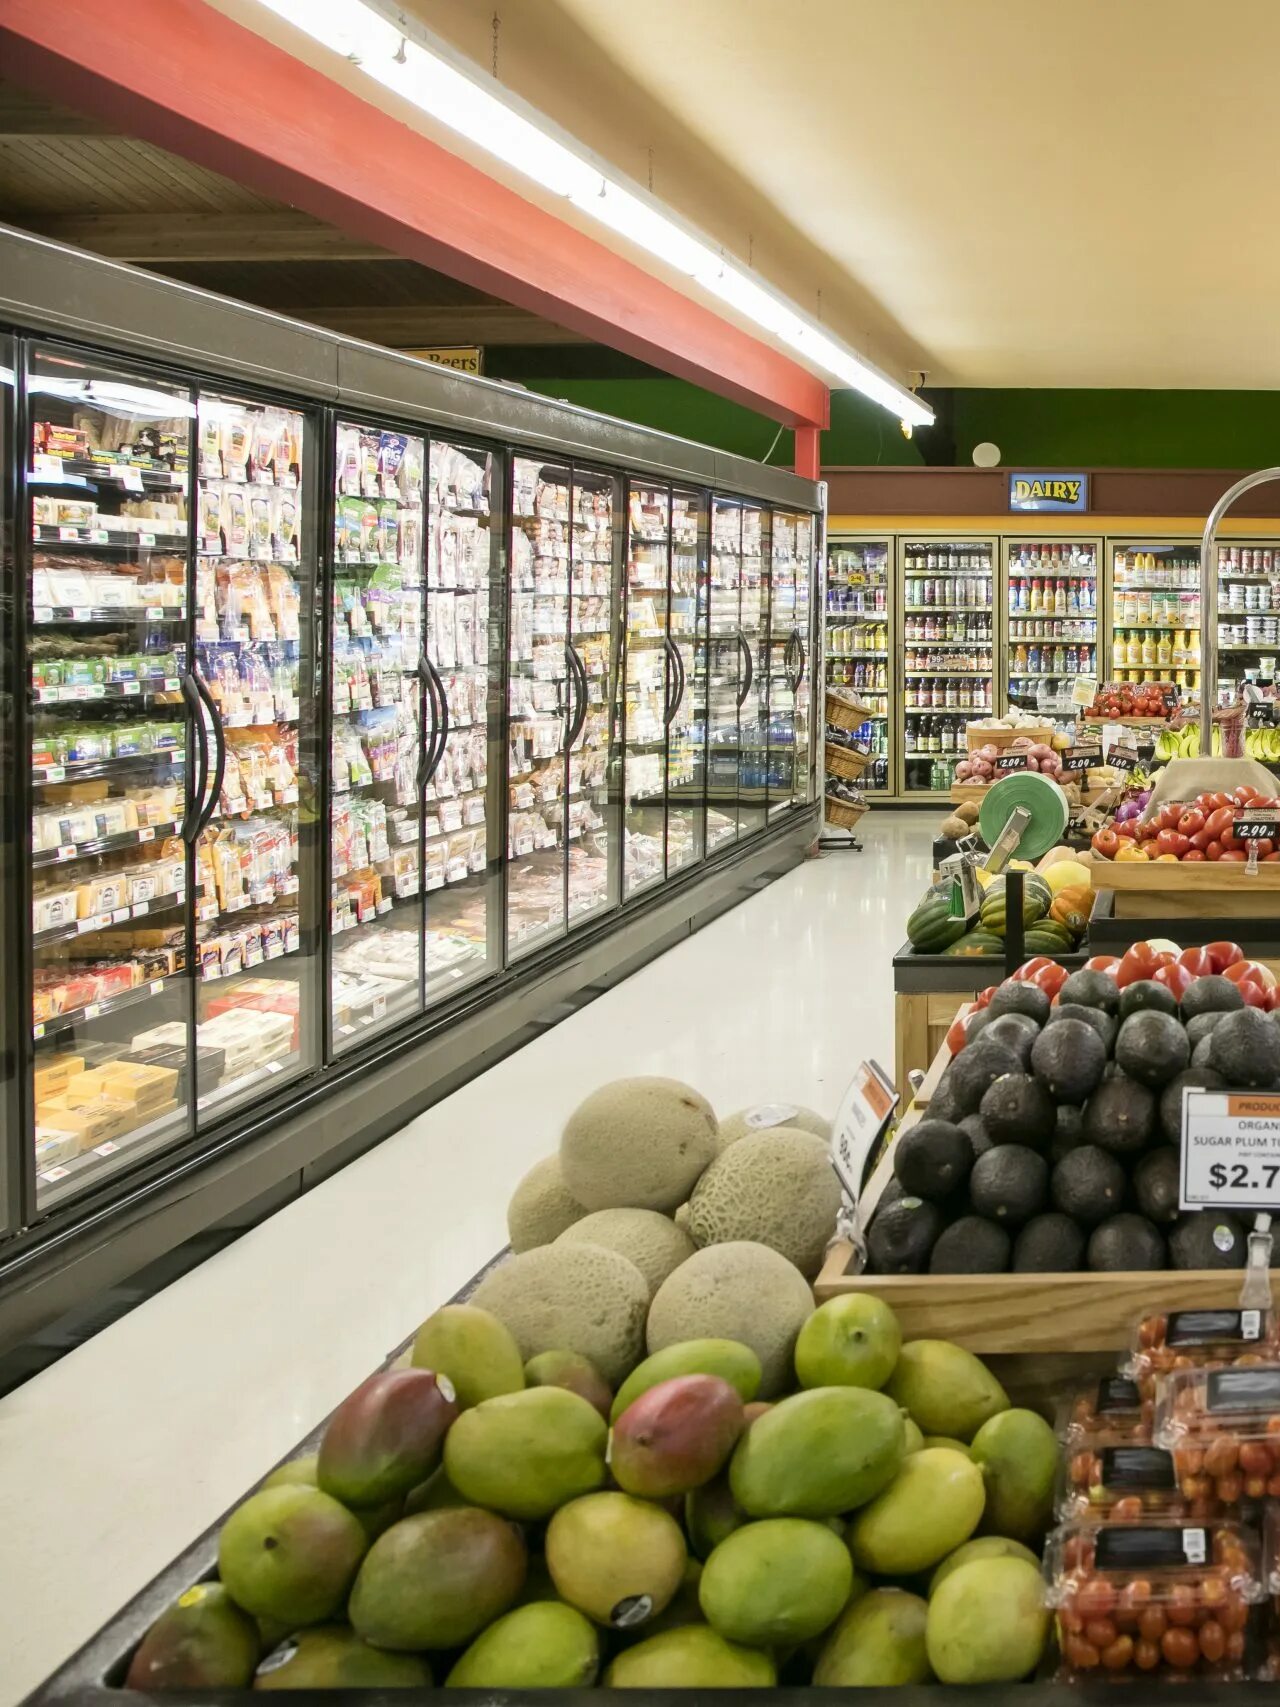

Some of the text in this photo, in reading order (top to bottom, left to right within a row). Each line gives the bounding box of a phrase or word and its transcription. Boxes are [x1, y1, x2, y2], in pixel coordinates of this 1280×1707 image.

[1015, 480, 1081, 502] DAIRY
[1237, 825, 1268, 837] $2.99
[1193, 1136, 1232, 1147] SUGAR
[1235, 1137, 1268, 1148] PLUM
